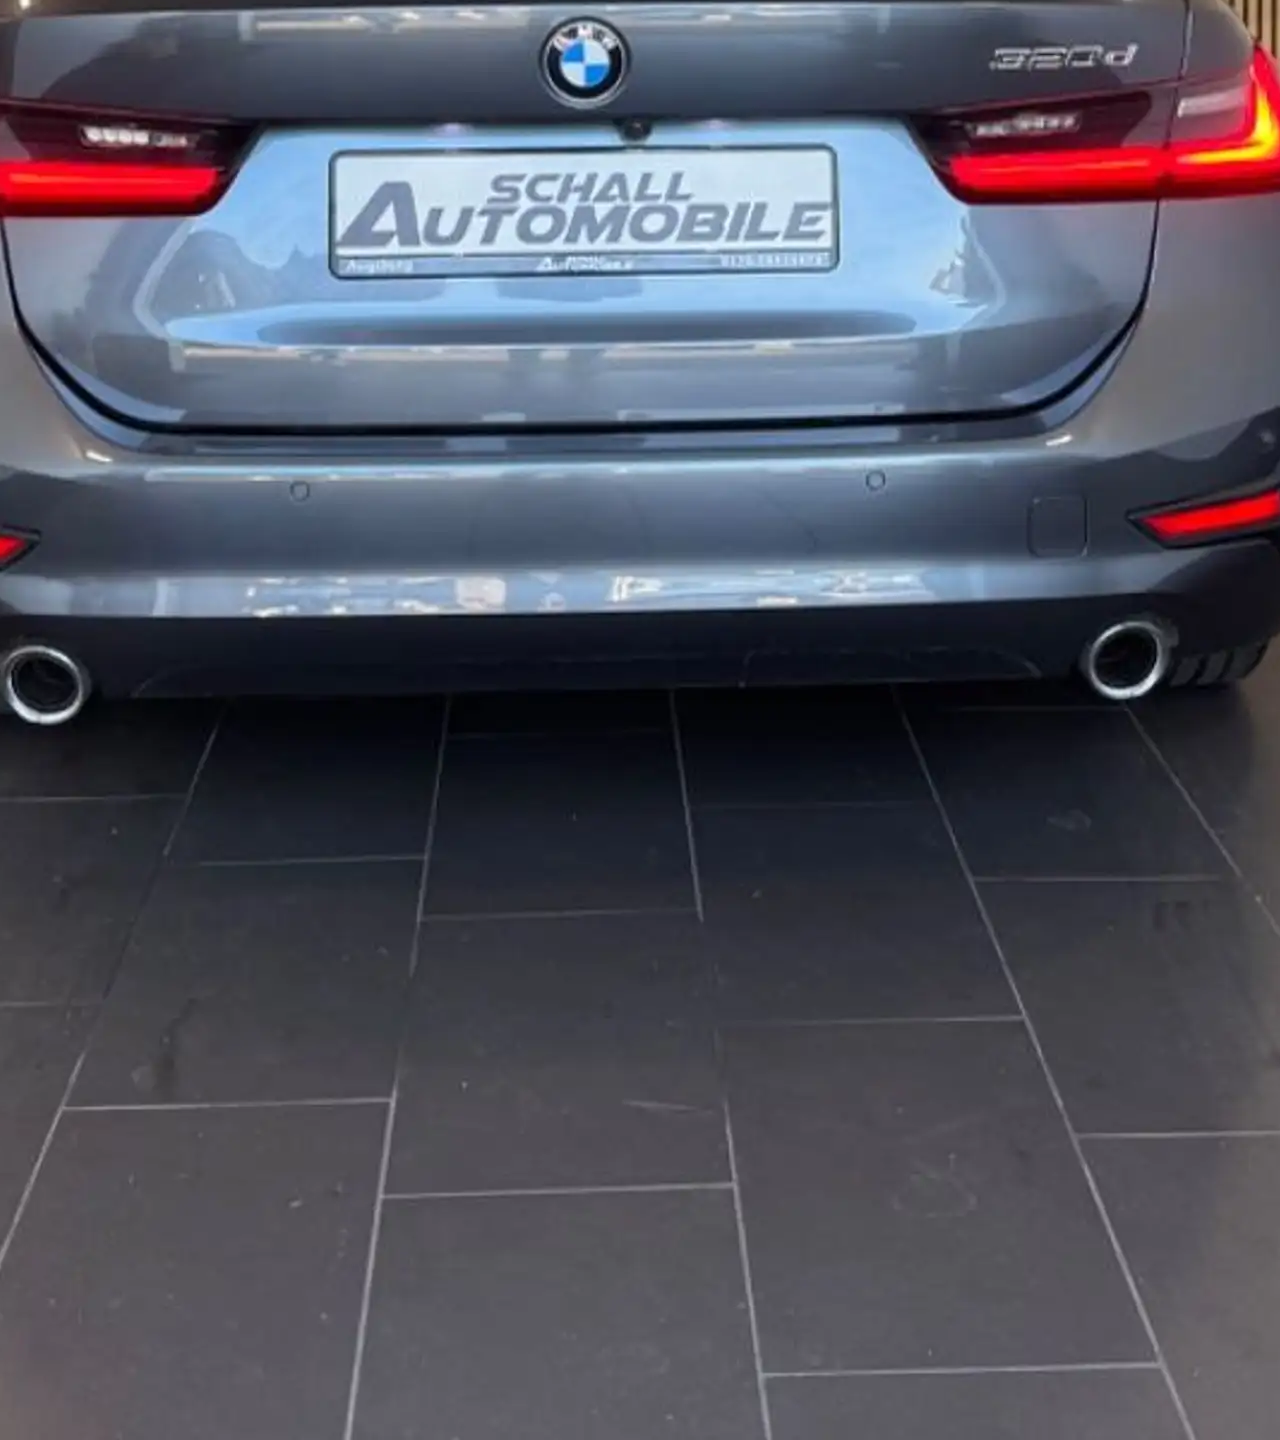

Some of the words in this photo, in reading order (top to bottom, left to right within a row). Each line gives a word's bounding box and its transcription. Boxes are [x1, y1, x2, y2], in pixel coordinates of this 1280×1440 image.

[989, 44, 1139, 73] 320d
[487, 171, 694, 205] SCHALL
[335, 181, 833, 248] AUTOMOBILE
